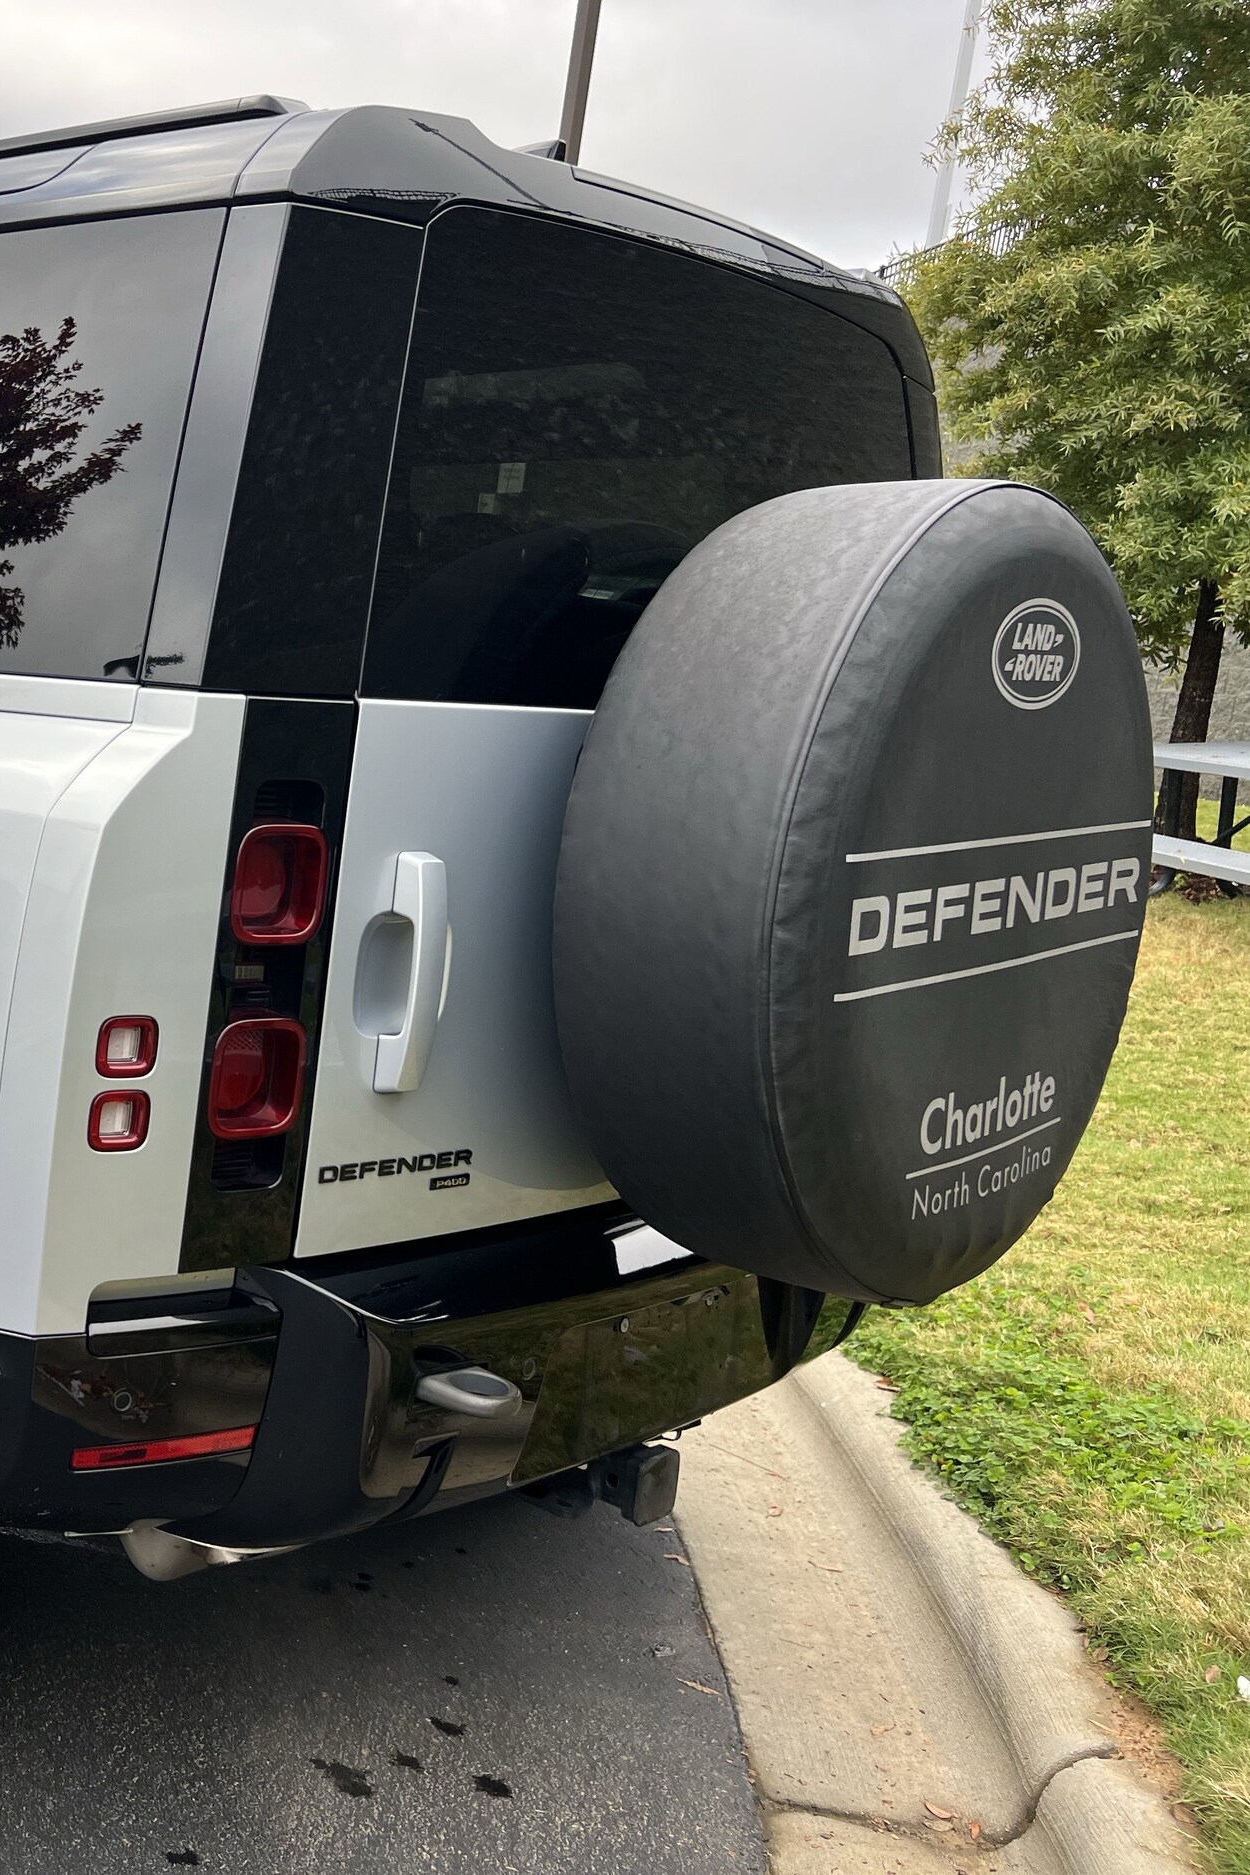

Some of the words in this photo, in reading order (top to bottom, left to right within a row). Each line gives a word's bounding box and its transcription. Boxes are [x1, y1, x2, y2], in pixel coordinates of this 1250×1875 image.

[1012, 622, 1056, 651] LAND
[1011, 653, 1064, 682] ROVER
[848, 856, 1140, 957] DEFENDER
[920, 1071, 1056, 1155] Charlotte
[318, 1148, 473, 1184] DEFENDER
[435, 1175, 467, 1188] P400
[911, 1171, 970, 1220] North
[977, 1145, 1052, 1198] Carolina
